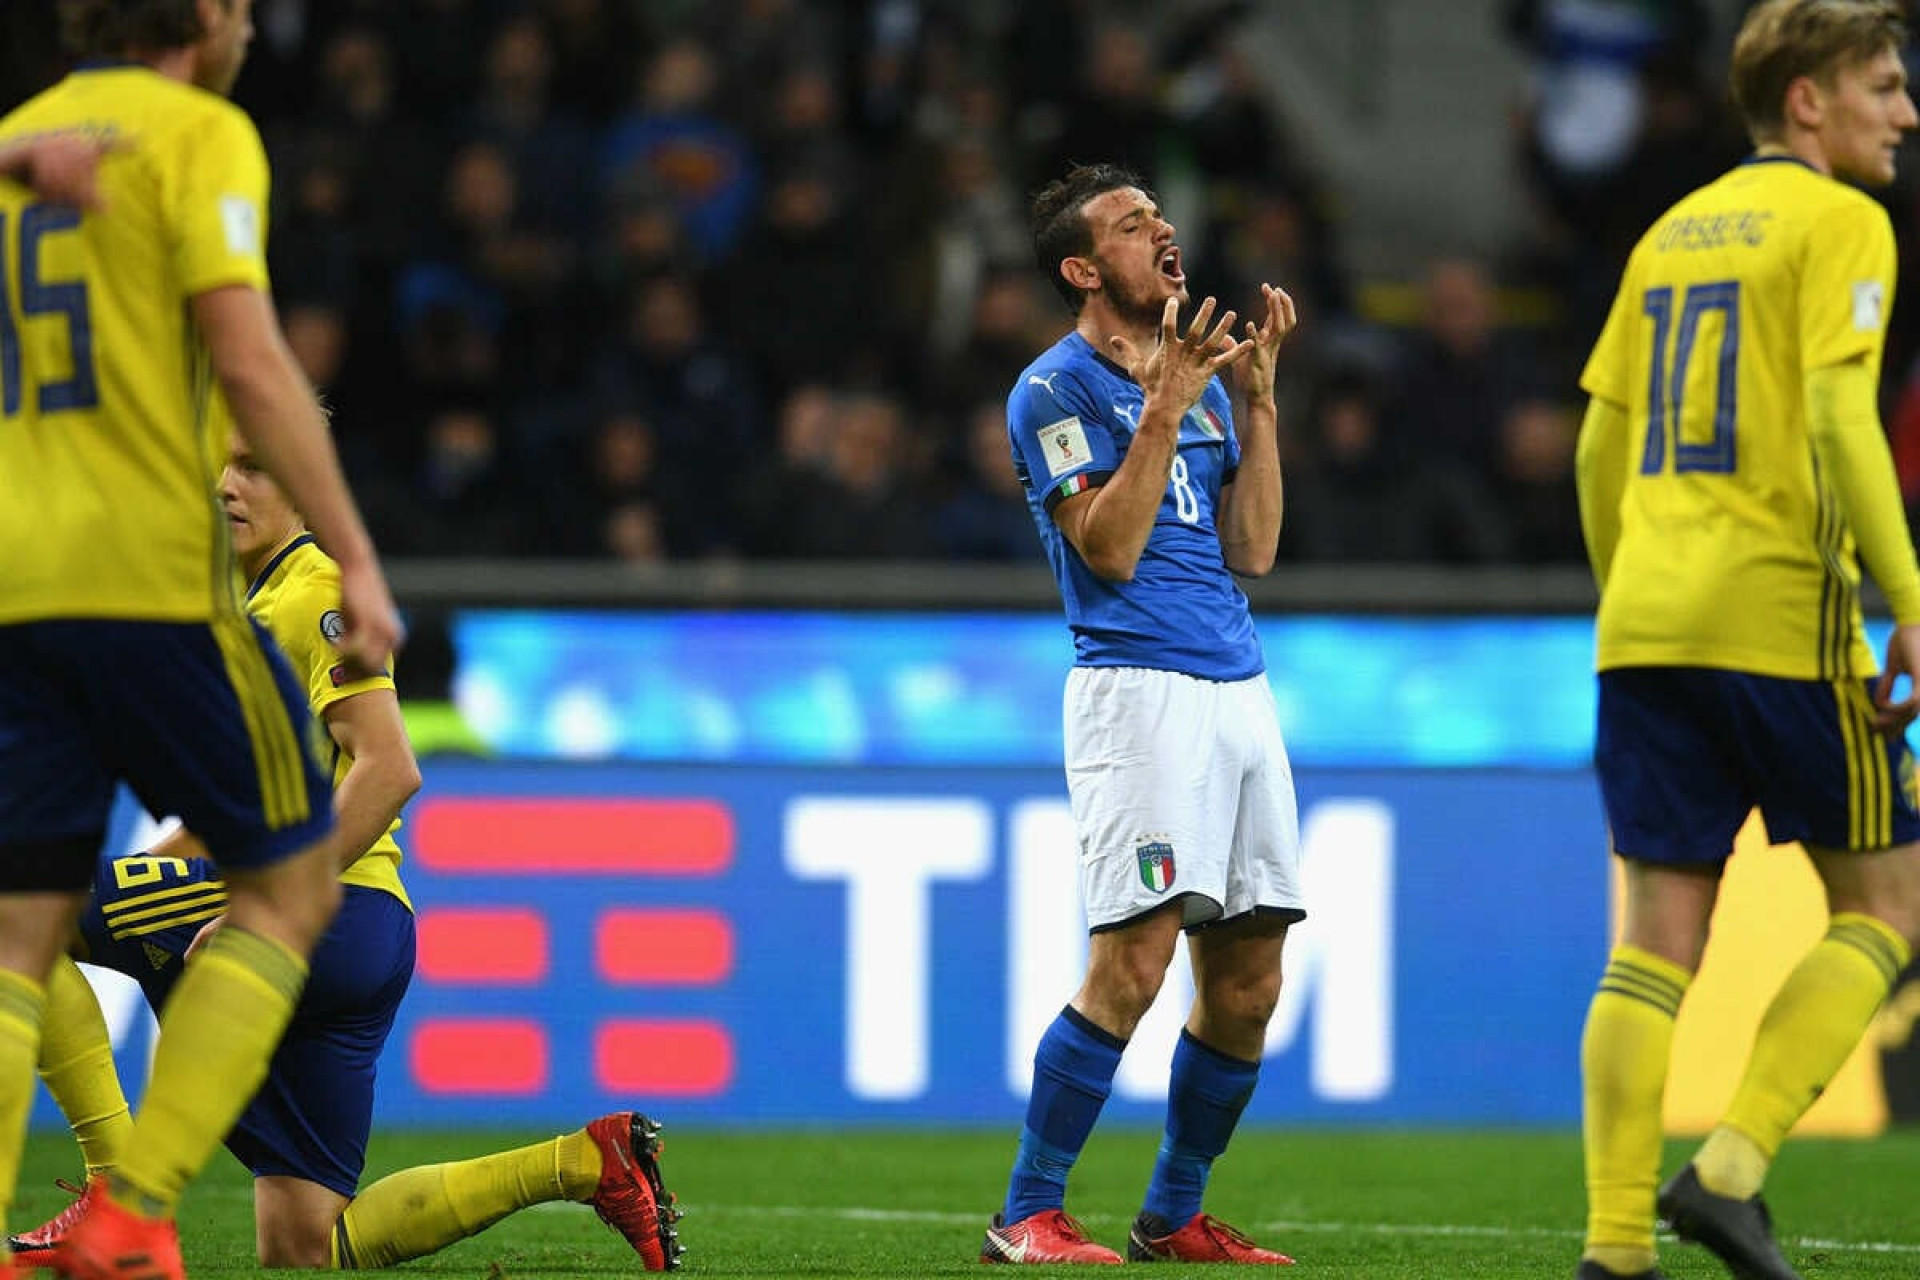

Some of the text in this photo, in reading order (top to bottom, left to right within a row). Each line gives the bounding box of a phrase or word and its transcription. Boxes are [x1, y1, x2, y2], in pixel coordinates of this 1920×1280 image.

[1656, 208, 1774, 252] ORSBERG
[0, 202, 99, 415] 15
[1640, 281, 1740, 475] 10
[1170, 453, 1199, 525] 8
[113, 856, 189, 889] 6
[786, 798, 1395, 1099] TIM
